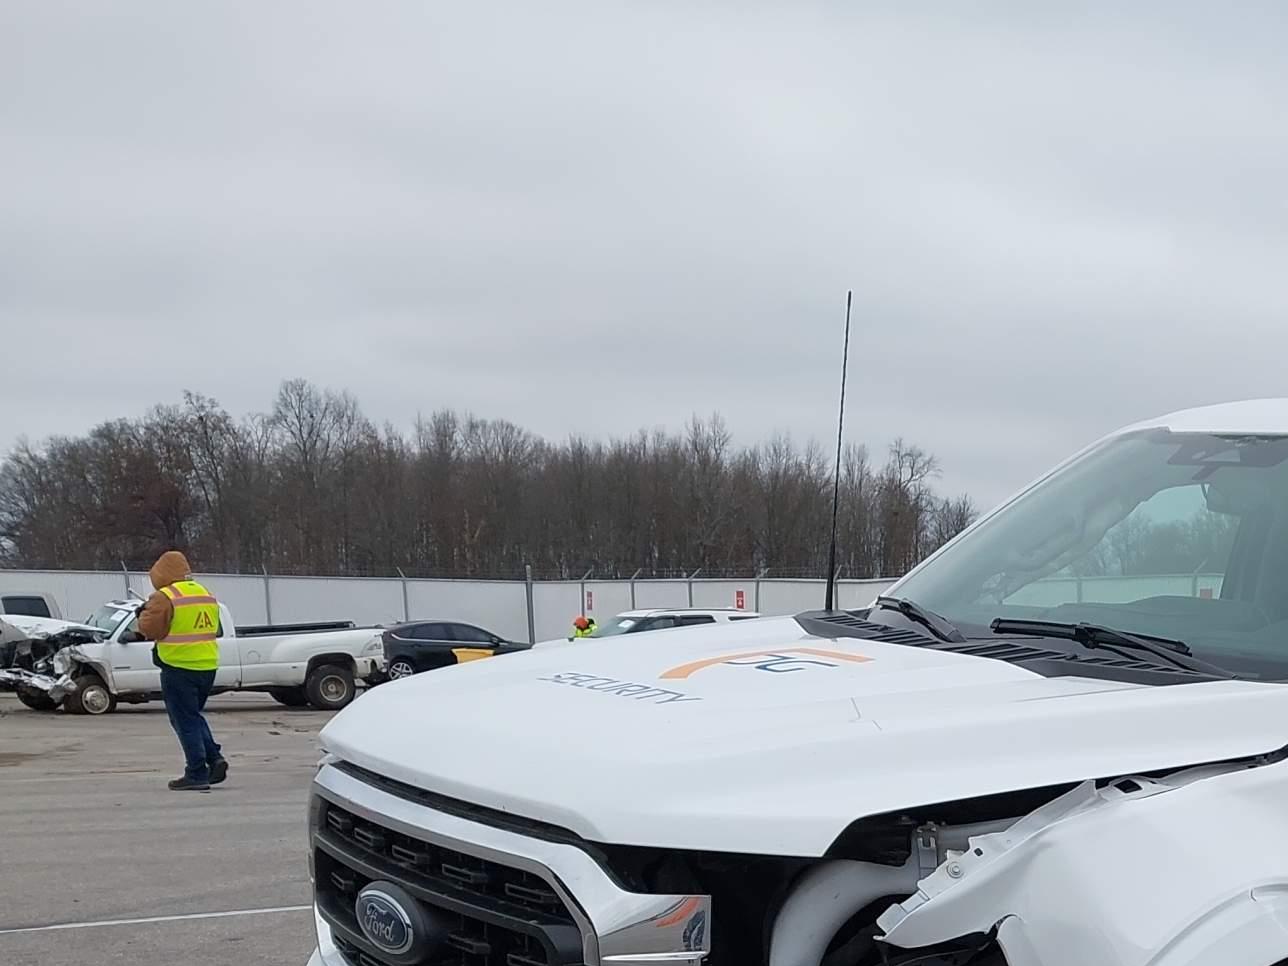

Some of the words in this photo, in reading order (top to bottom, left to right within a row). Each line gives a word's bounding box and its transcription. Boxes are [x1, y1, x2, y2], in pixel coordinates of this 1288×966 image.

[720, 653, 839, 673] JG
[536, 672, 703, 704] SECURITY
[364, 902, 396, 942] Ford
